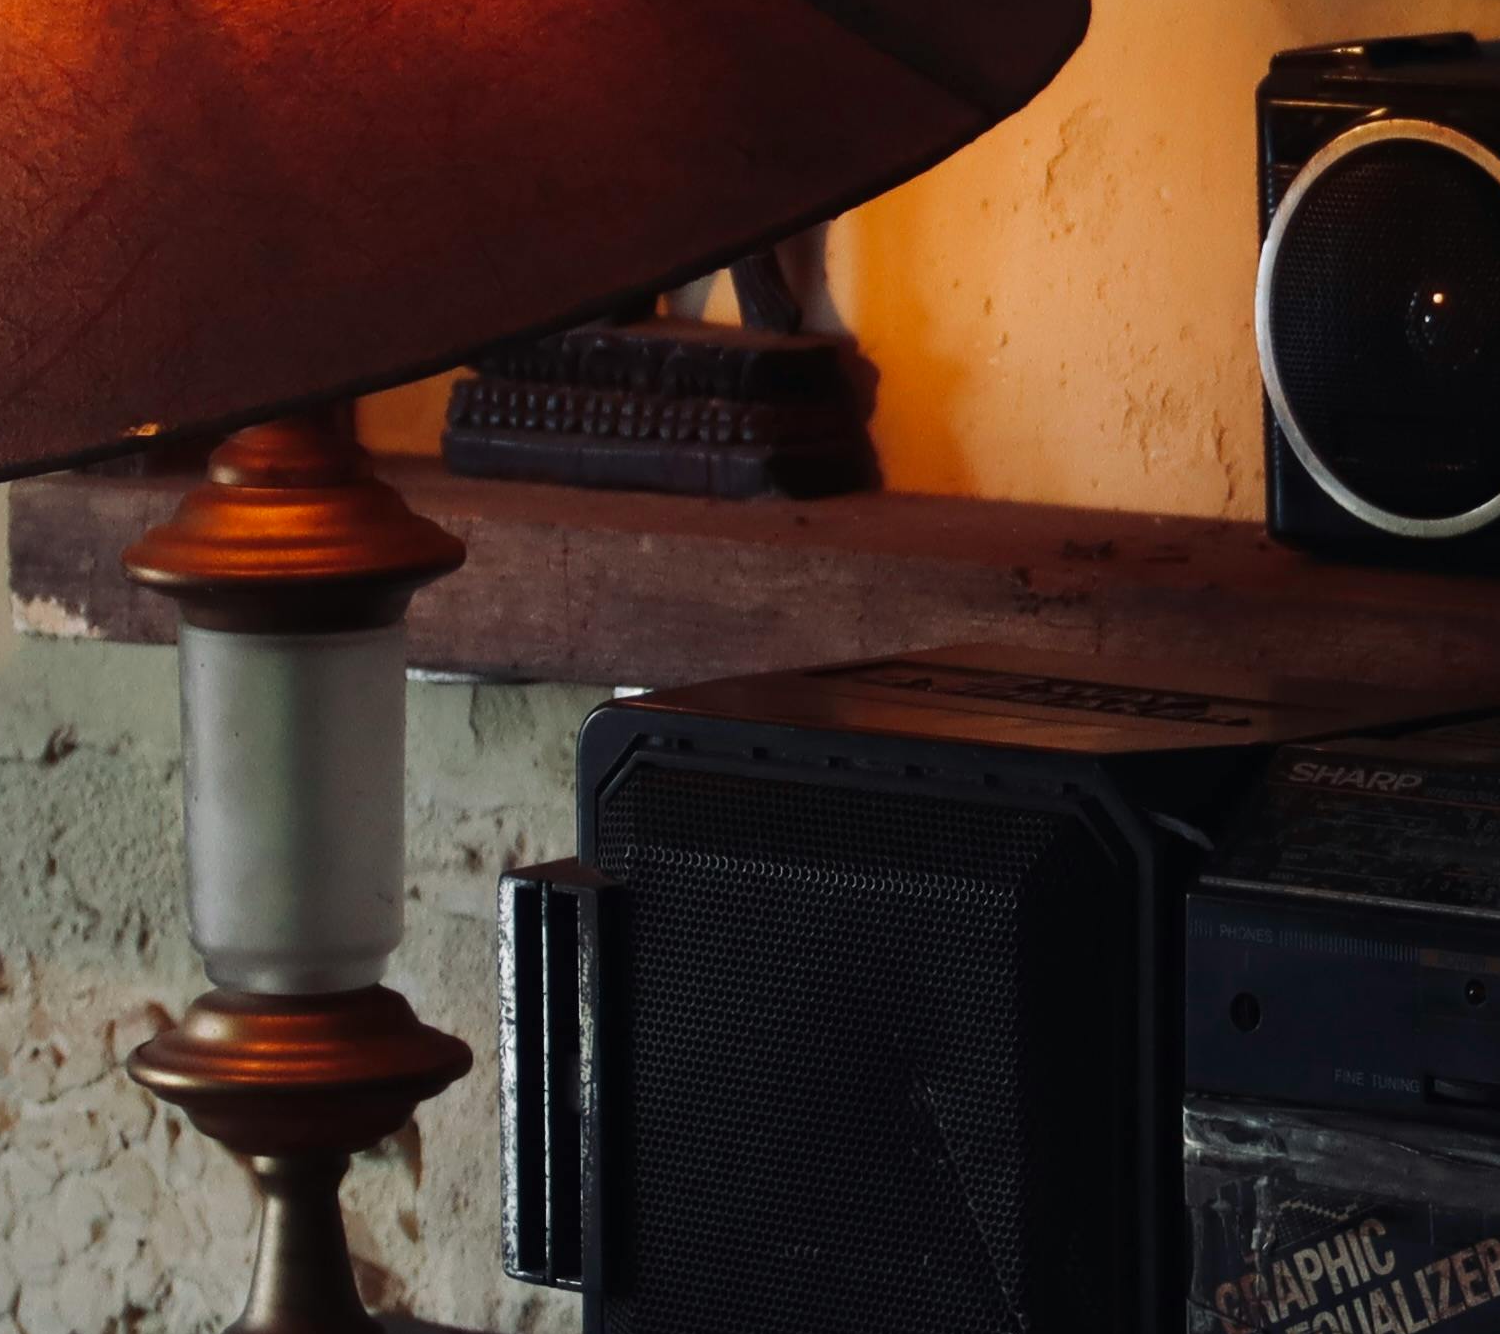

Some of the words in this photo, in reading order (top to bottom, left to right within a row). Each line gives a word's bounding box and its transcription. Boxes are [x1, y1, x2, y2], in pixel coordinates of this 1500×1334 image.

[1288, 761, 1424, 792] SHARP
[1218, 925, 1275, 947] PHONES
[1334, 1070, 1366, 1088] FINE
[1369, 1073, 1421, 1095] TUNING
